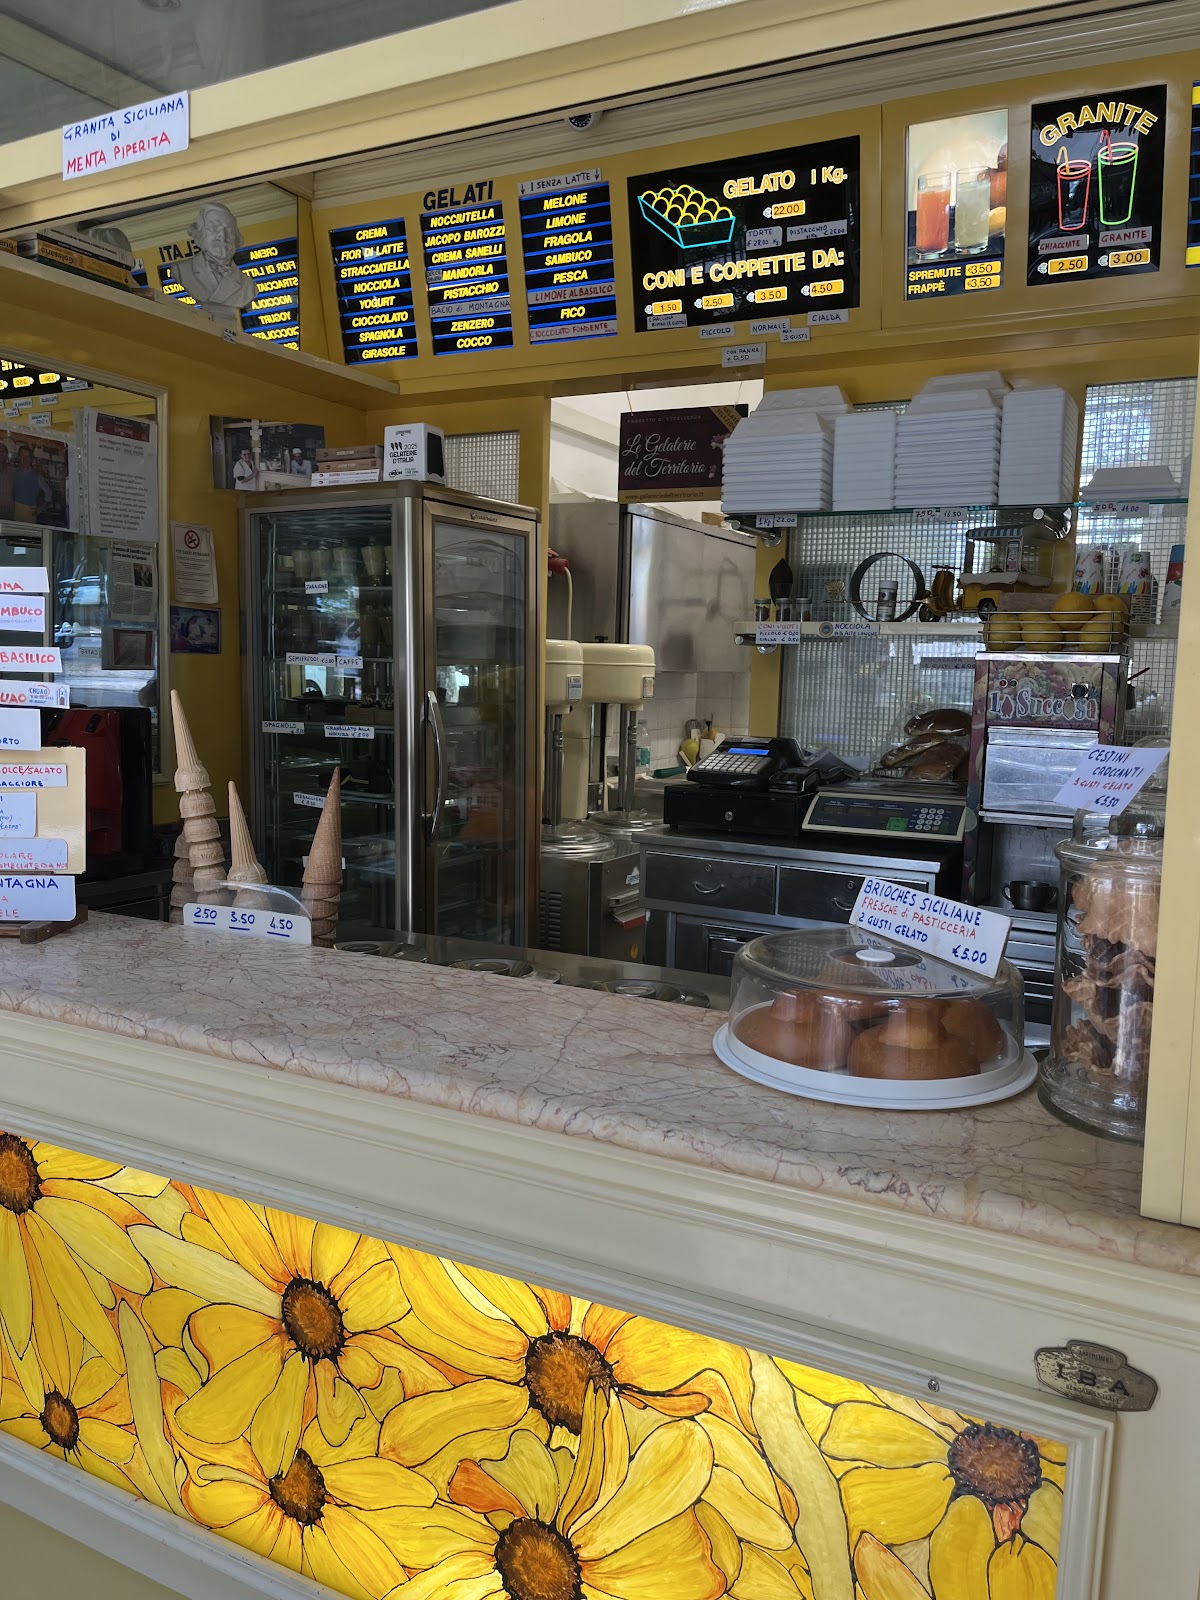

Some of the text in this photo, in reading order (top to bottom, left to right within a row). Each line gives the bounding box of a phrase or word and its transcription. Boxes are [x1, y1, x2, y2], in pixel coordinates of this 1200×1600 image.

[64, 98, 184, 142] GRANITA SICILIANA
[1040, 102, 1158, 146] GRANITE
[111, 130, 120, 142] DI
[66, 131, 170, 174] MENTA PIPERITA
[536, 178, 561, 189] SENZA
[566, 172, 590, 185] LATTE
[724, 170, 795, 199] GELATO
[822, 166, 848, 184] Kg.
[423, 180, 494, 210] GELATI
[543, 192, 588, 210] MELONE
[430, 208, 494, 228] NOCCIUTELLA
[546, 212, 586, 229] LIMONE
[356, 227, 388, 241] CREMA
[425, 226, 505, 248] JACOPO BAROZZI
[748, 229, 772, 237] TORTE
[790, 225, 828, 235] PISTACCHIO
[1102, 230, 1147, 242] GRANITE
[544, 230, 592, 248] FRAGOLA
[1040, 240, 1080, 250] GHIACCIATE
[340, 242, 404, 261] FIOR DI LATTE
[432, 244, 502, 263] CREMA SANELLI
[545, 250, 592, 266] SAMBUCO
[340, 260, 410, 278] STRACCIATELLA
[442, 264, 494, 280] MANDORLA
[553, 270, 588, 284] PESCA
[643, 248, 844, 290] CONI E COPPETTE DA:
[909, 267, 962, 281] SPREMUTE
[354, 278, 400, 293] NOCCIOLA
[443, 282, 499, 300] PISTACCHIO
[908, 280, 945, 294] FRAPPÈ
[360, 296, 396, 309] YOGURT
[536, 290, 566, 302] LIMONE
[432, 306, 452, 314] BACIO
[469, 300, 510, 312] MONTAGNA
[560, 306, 586, 319] FICO
[352, 311, 408, 328] CIOCCOLATO
[451, 318, 494, 332] ZENZERO
[812, 314, 841, 322] CIALDA
[359, 328, 404, 342] SPAGNOLA
[530, 328, 570, 338] CIOCCOLATO
[572, 322, 608, 333] FONDENTE
[702, 327, 731, 336] PICCOLO
[752, 322, 786, 332] NORMALE
[456, 335, 492, 349] COCCO
[362, 346, 406, 359] GIRASOLE
[622, 433, 696, 461] Le Gelaterie
[624, 458, 706, 478] del Territorio
[624, 491, 704, 500] www.gelateriedelterritorio.it
[1088, 750, 1130, 764] CESTINI
[1092, 766, 1144, 778] CROCCANTI
[1080, 780, 1100, 789] GUSTI
[1102, 782, 1134, 790] GELATO
[864, 880, 982, 926] BRIOCHES SICILIANE
[194, 906, 294, 930] 2.50 3.50 4.50
[862, 896, 976, 940] FRESCHE di PASTICCERIA
[858, 912, 928, 942] 2 GUSTI GELATO
